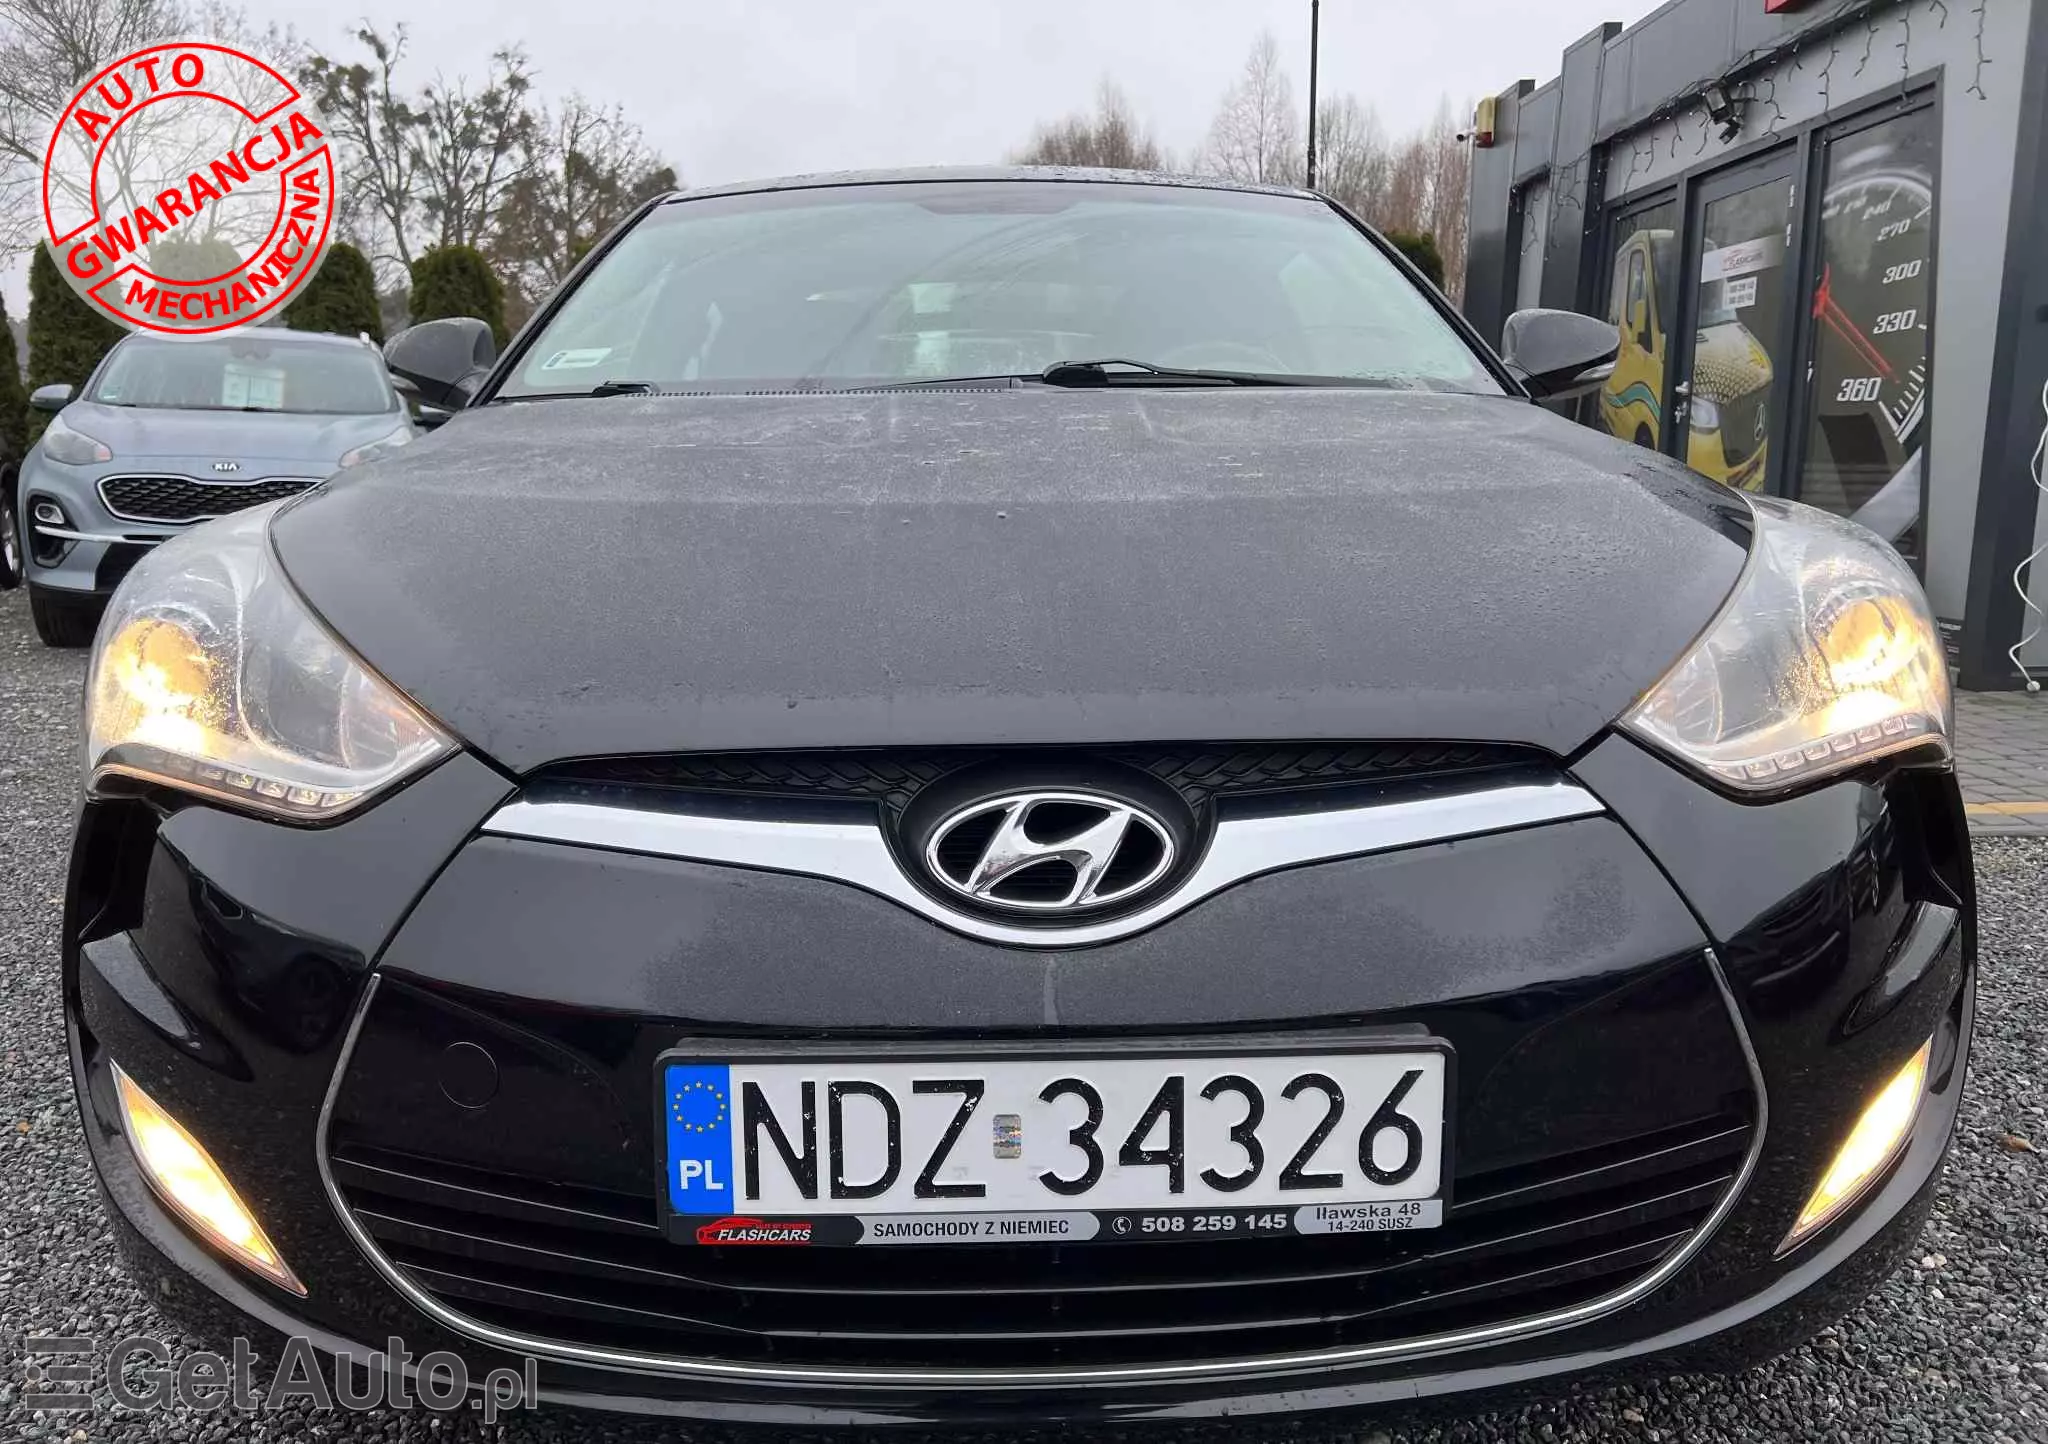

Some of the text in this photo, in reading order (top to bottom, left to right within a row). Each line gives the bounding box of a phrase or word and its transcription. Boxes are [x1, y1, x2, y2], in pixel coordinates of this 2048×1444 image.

[1877, 218, 1911, 241] 270
[1882, 259, 1922, 284] 300
[1873, 309, 1917, 334] 330
[1836, 377, 1882, 402] 360
[214, 461, 238, 471] KIA
[742, 1069, 1424, 1200] NDZ 34326
[679, 1159, 724, 1191] PL
[1398, 1202, 1421, 1216] 48
[873, 1220, 1069, 1237] SAMOCHODY Z NIEMIEC
[1141, 1213, 1287, 1233] 508 259 145
[1328, 1217, 1413, 1232] 14-240 SUSZ
[717, 1229, 812, 1241] FLASHCARS
